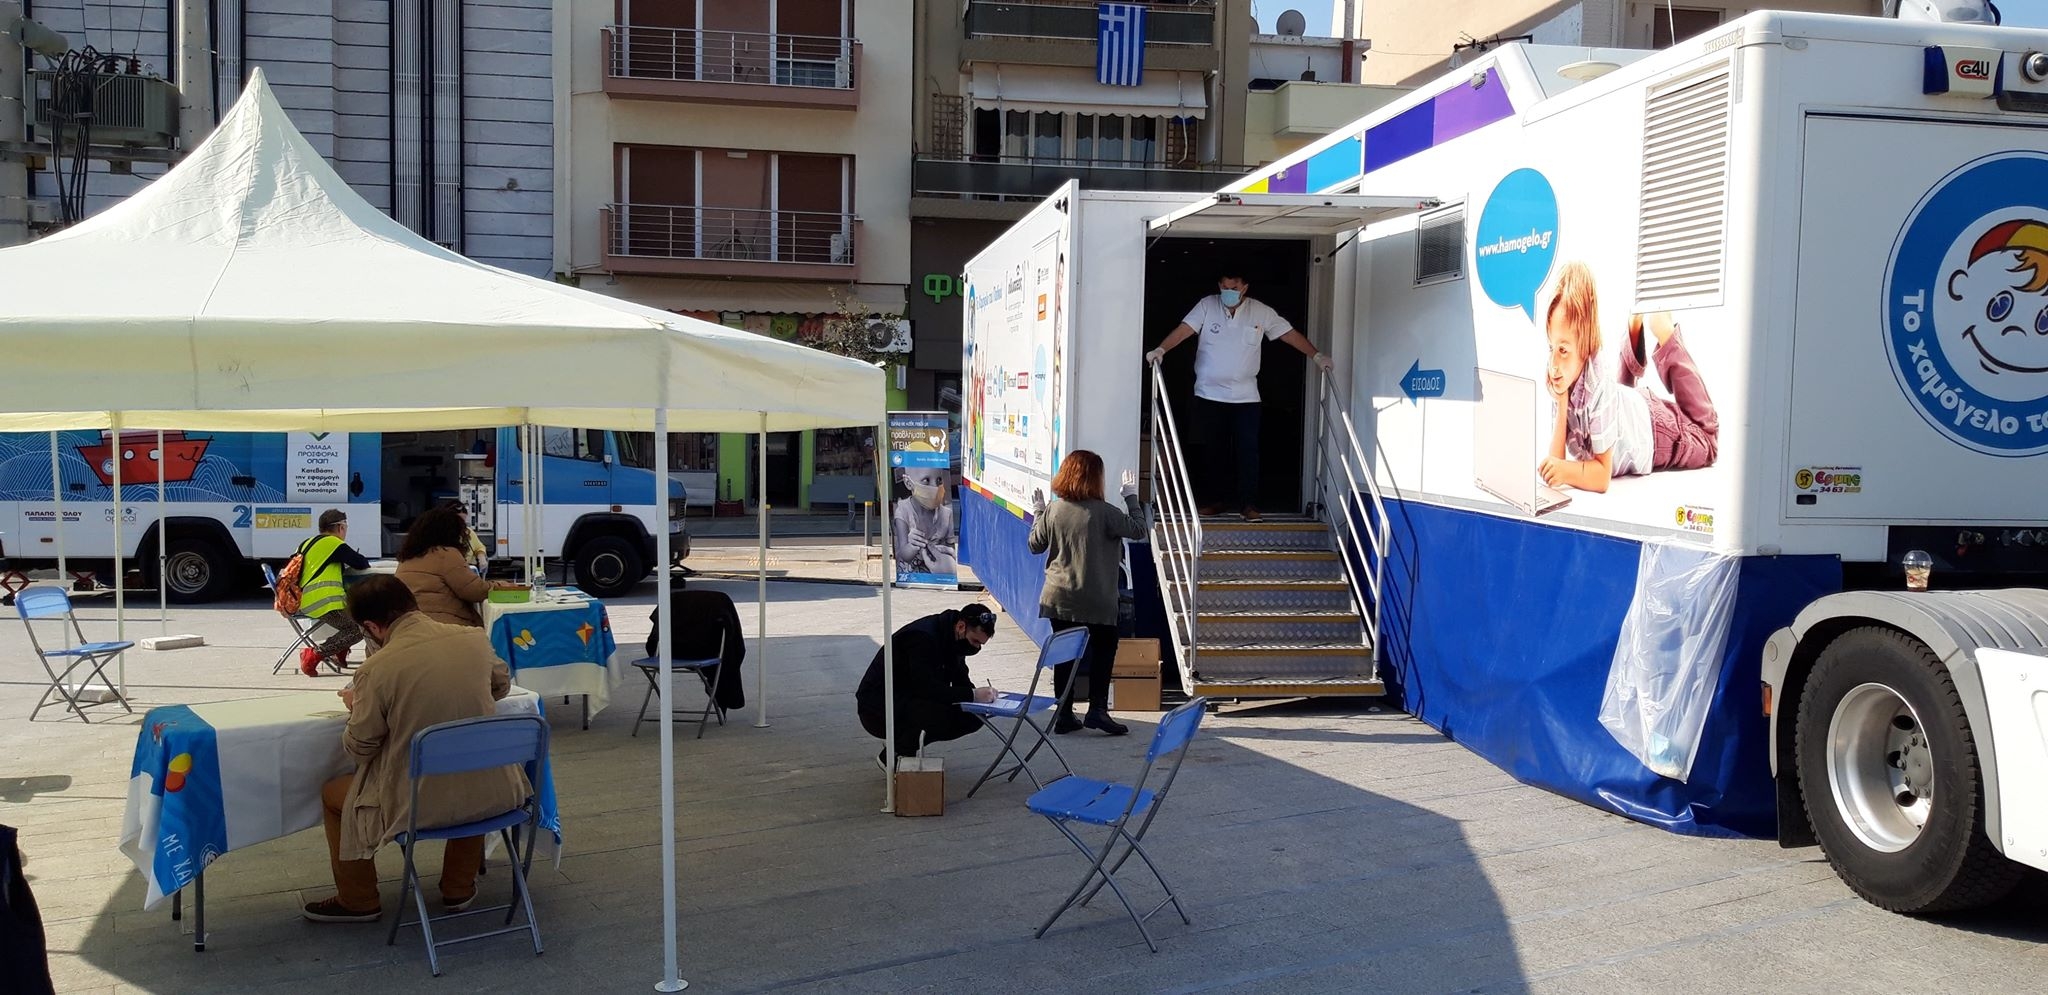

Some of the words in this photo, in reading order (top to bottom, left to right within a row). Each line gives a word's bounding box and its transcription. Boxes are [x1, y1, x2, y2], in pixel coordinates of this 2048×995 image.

[1479, 228, 1552, 257] www.hamogelo.gr
[1903, 289, 1925, 332] Το
[1411, 377, 1440, 391] ΕΙΣΟΔΟΣ
[1907, 338, 2019, 435] χαμόγελο
[272, 518, 302, 528] ΥΓΕΙΑΣ
[162, 833, 184, 857] ΜΕ
